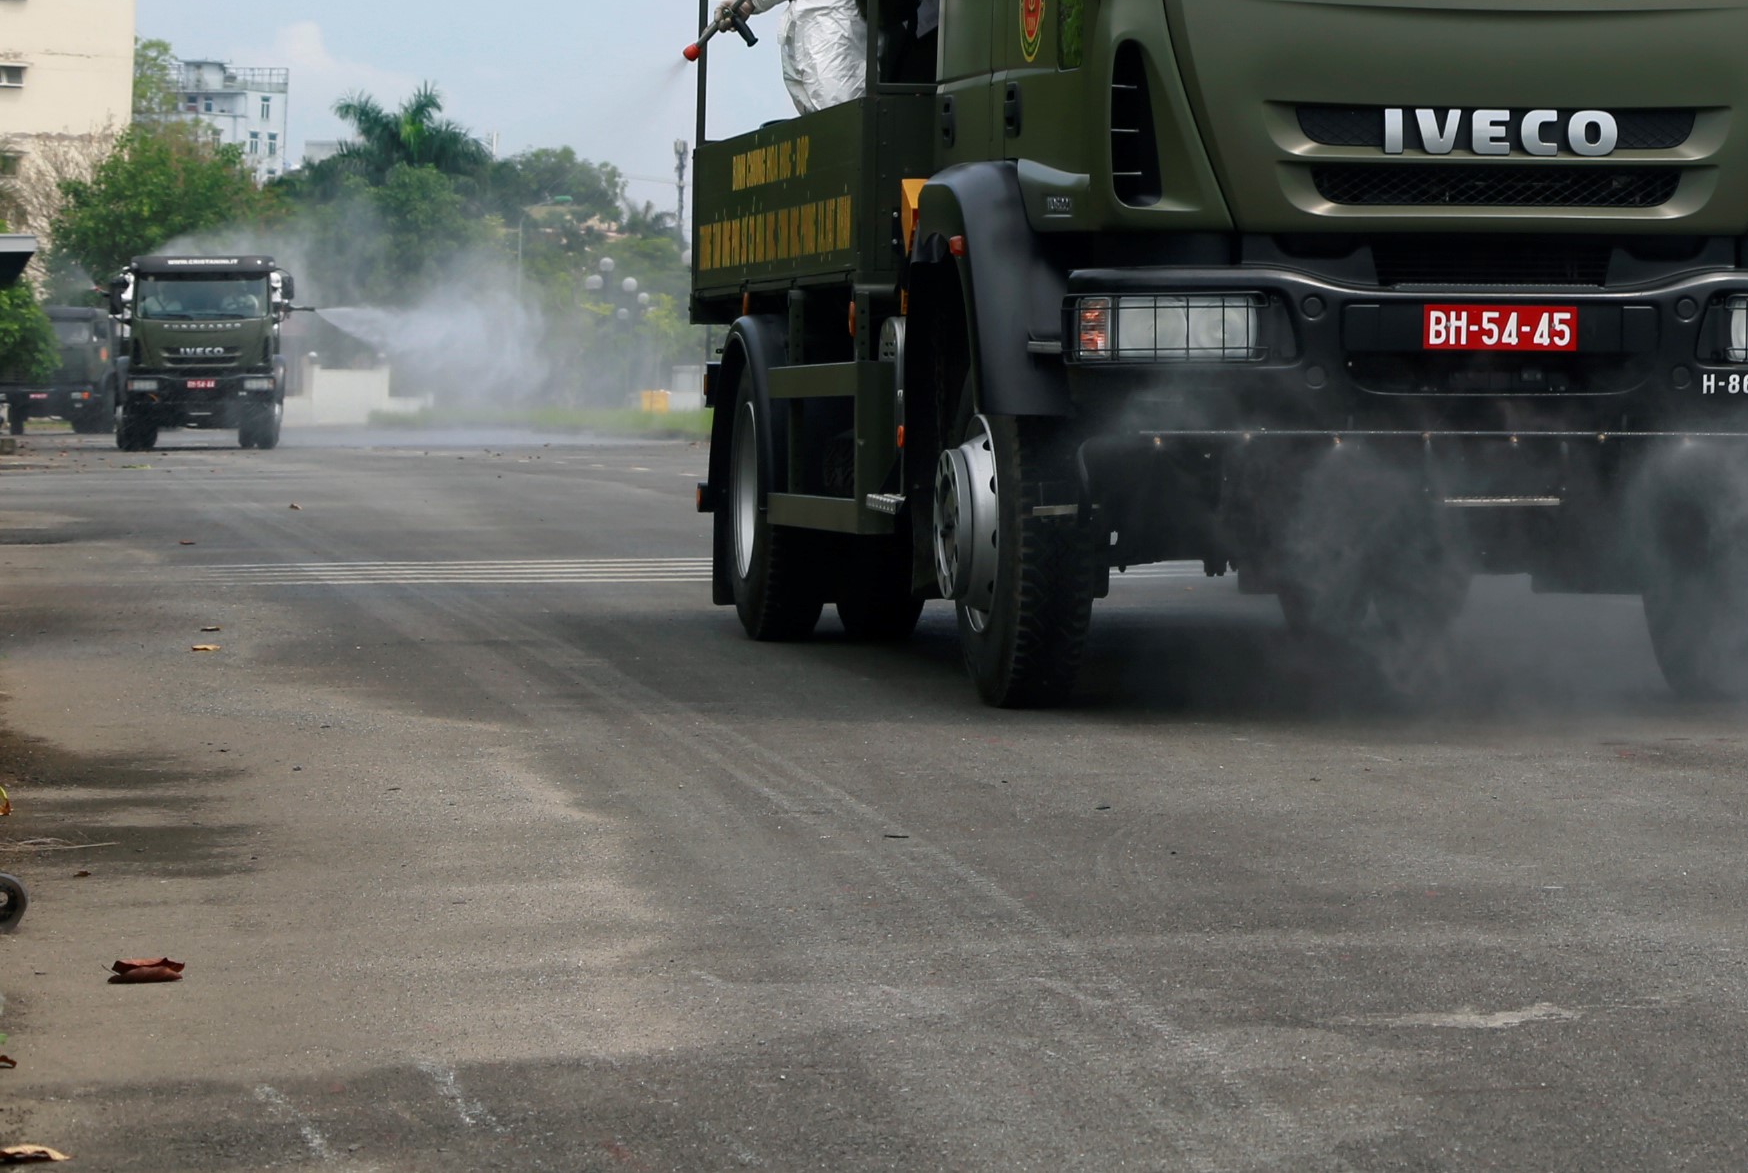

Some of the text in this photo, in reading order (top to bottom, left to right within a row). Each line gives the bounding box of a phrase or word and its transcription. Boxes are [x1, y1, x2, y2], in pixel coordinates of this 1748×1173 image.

[1383, 108, 1618, 156] IVECO
[1428, 309, 1572, 349] BH-54-45
[180, 346, 225, 356] IVECO
